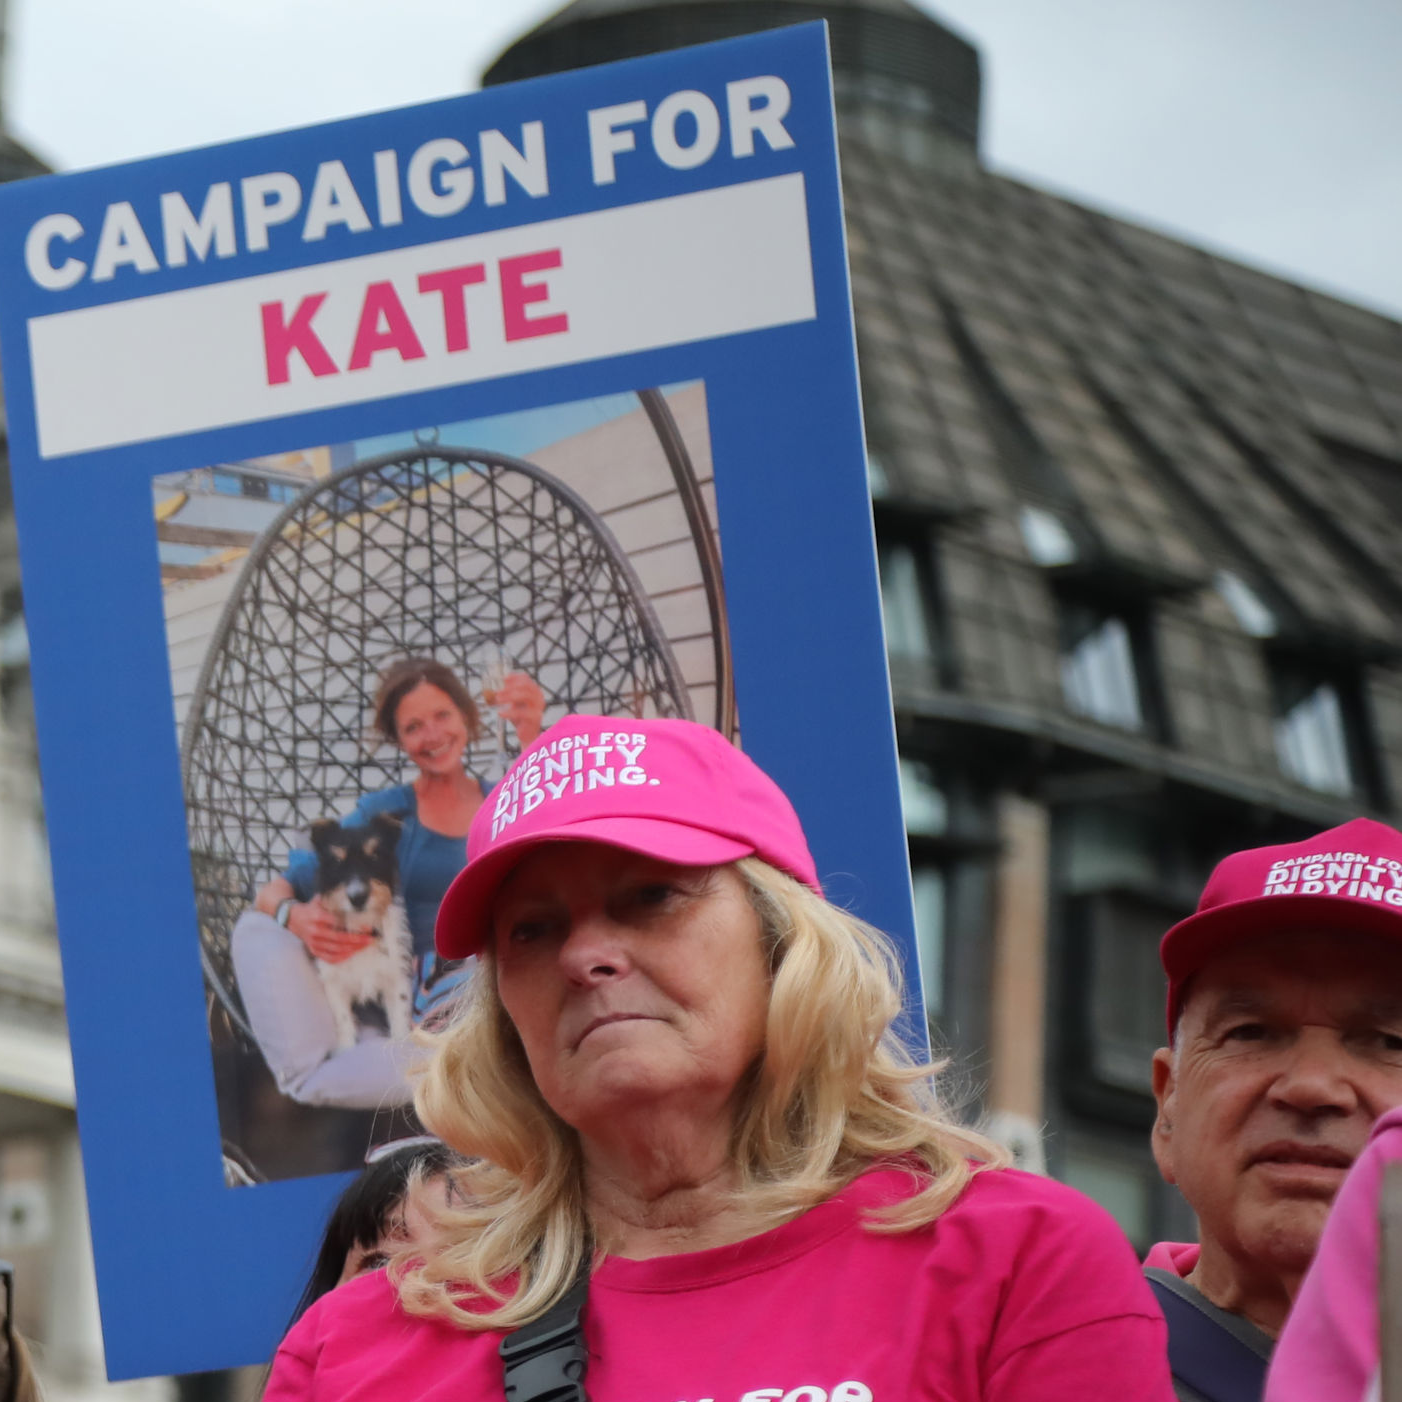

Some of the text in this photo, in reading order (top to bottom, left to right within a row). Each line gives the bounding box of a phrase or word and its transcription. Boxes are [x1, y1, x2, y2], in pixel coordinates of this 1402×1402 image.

[24, 75, 795, 291] CAMPAIGN FOR
[260, 249, 569, 386] KATE
[492, 744, 646, 821] DIGNITY
[500, 732, 647, 796] CAMPAIGN FOR
[491, 766, 661, 842] IN DYING.
[1261, 882, 1298, 897] IN
[1265, 861, 1402, 889] DIGNITY
[1270, 851, 1402, 872] CAMPAIGN FO
